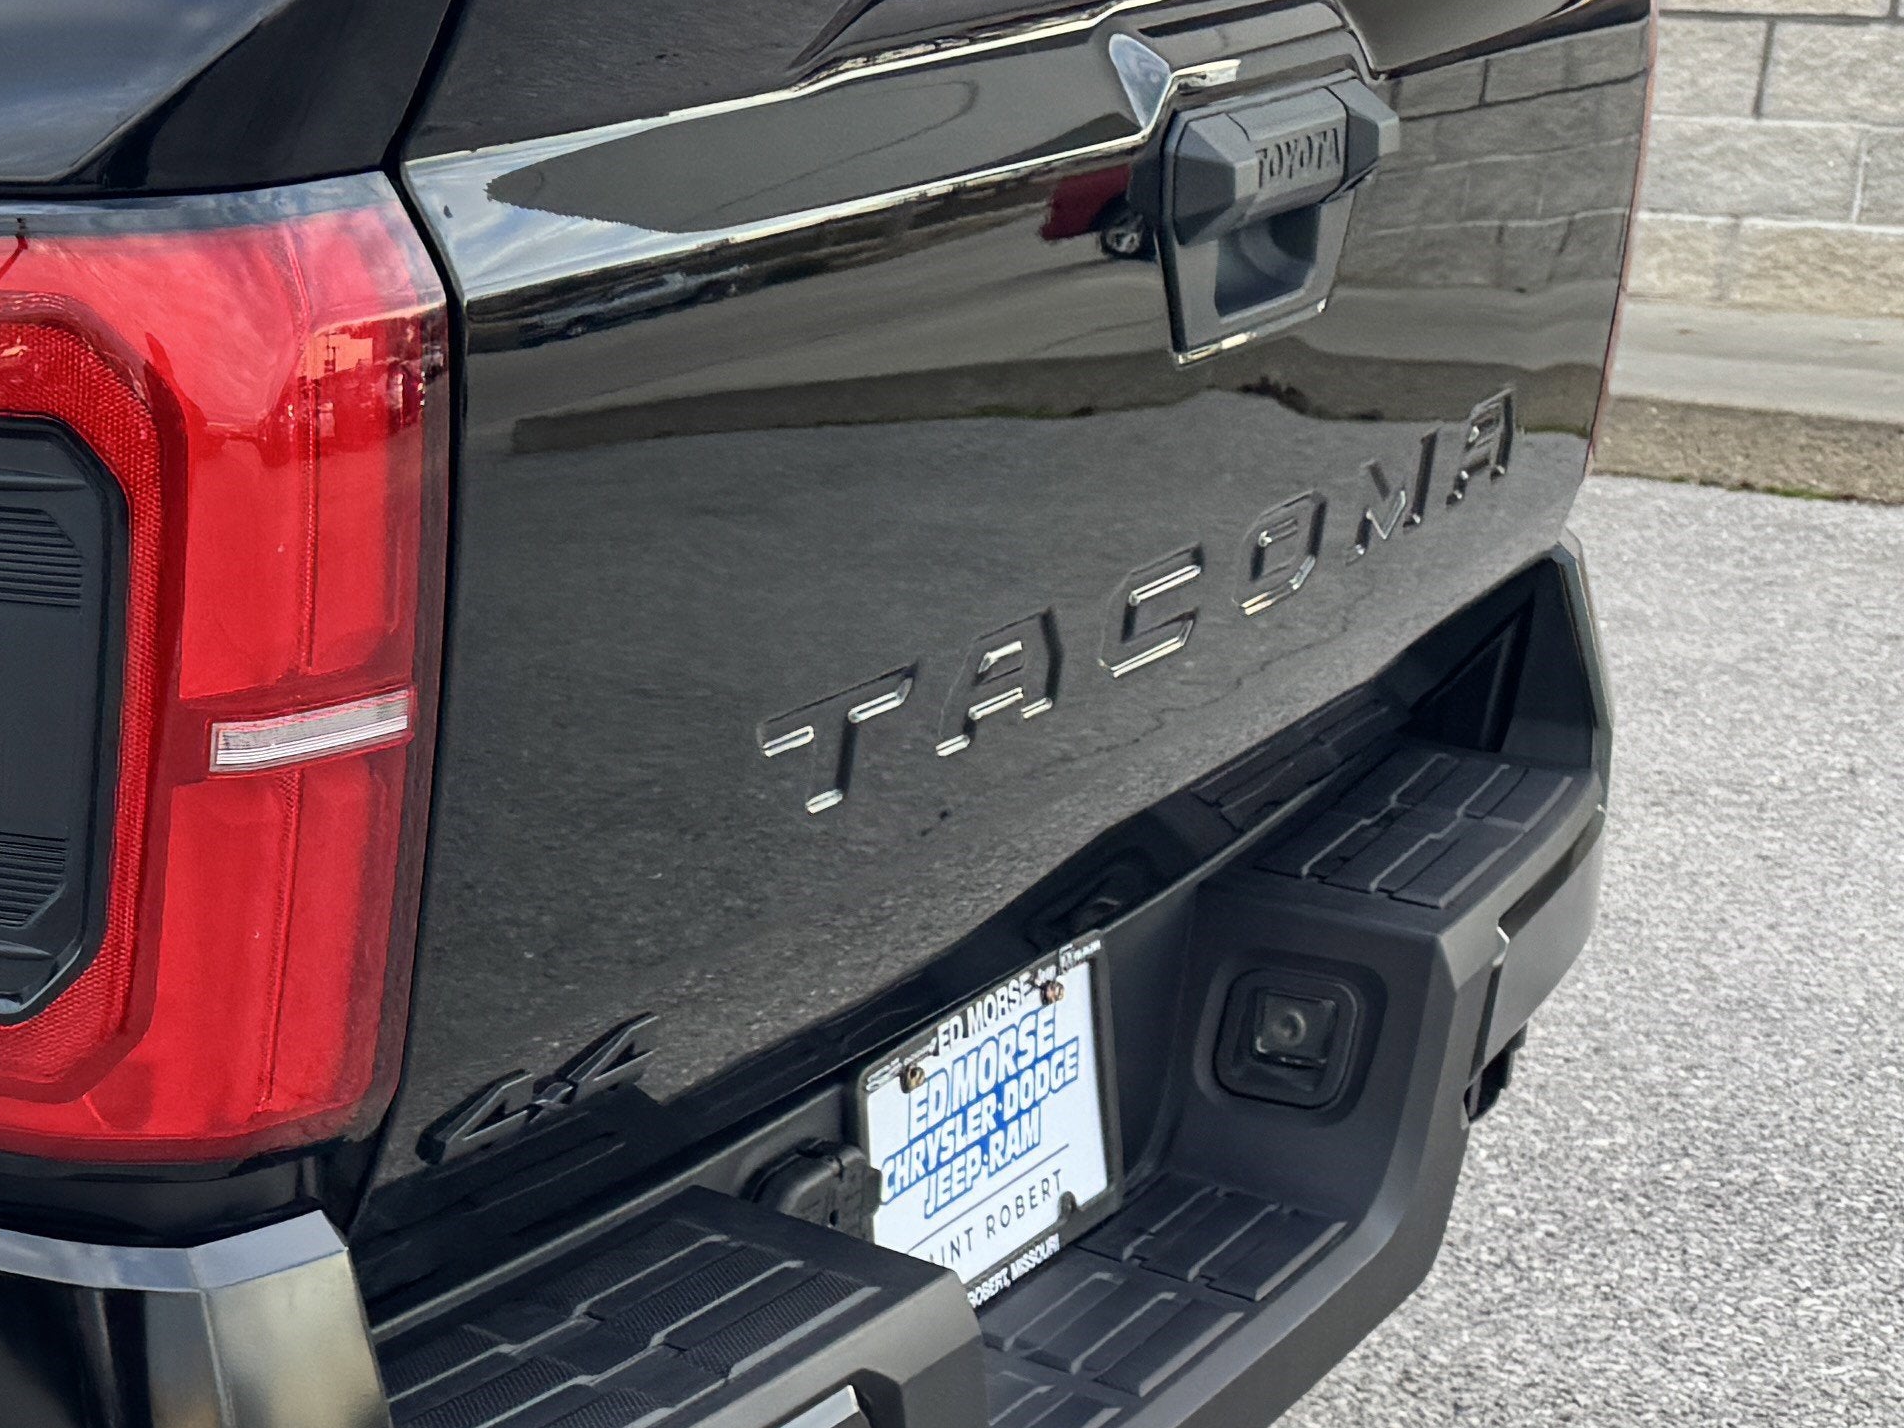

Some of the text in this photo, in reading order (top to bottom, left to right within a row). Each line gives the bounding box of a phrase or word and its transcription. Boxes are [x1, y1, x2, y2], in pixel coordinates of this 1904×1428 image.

[1253, 126, 1345, 191] TOYOTA
[755, 382, 1518, 816] TACOMA
[936, 1014, 964, 1056] ED
[966, 971, 1033, 1038] MORSE
[910, 1068, 952, 1135] ED
[951, 1005, 1056, 1112] MORSE
[985, 1168, 1062, 1240] ROBERT
[1009, 1232, 1061, 1281] MISSOURI
